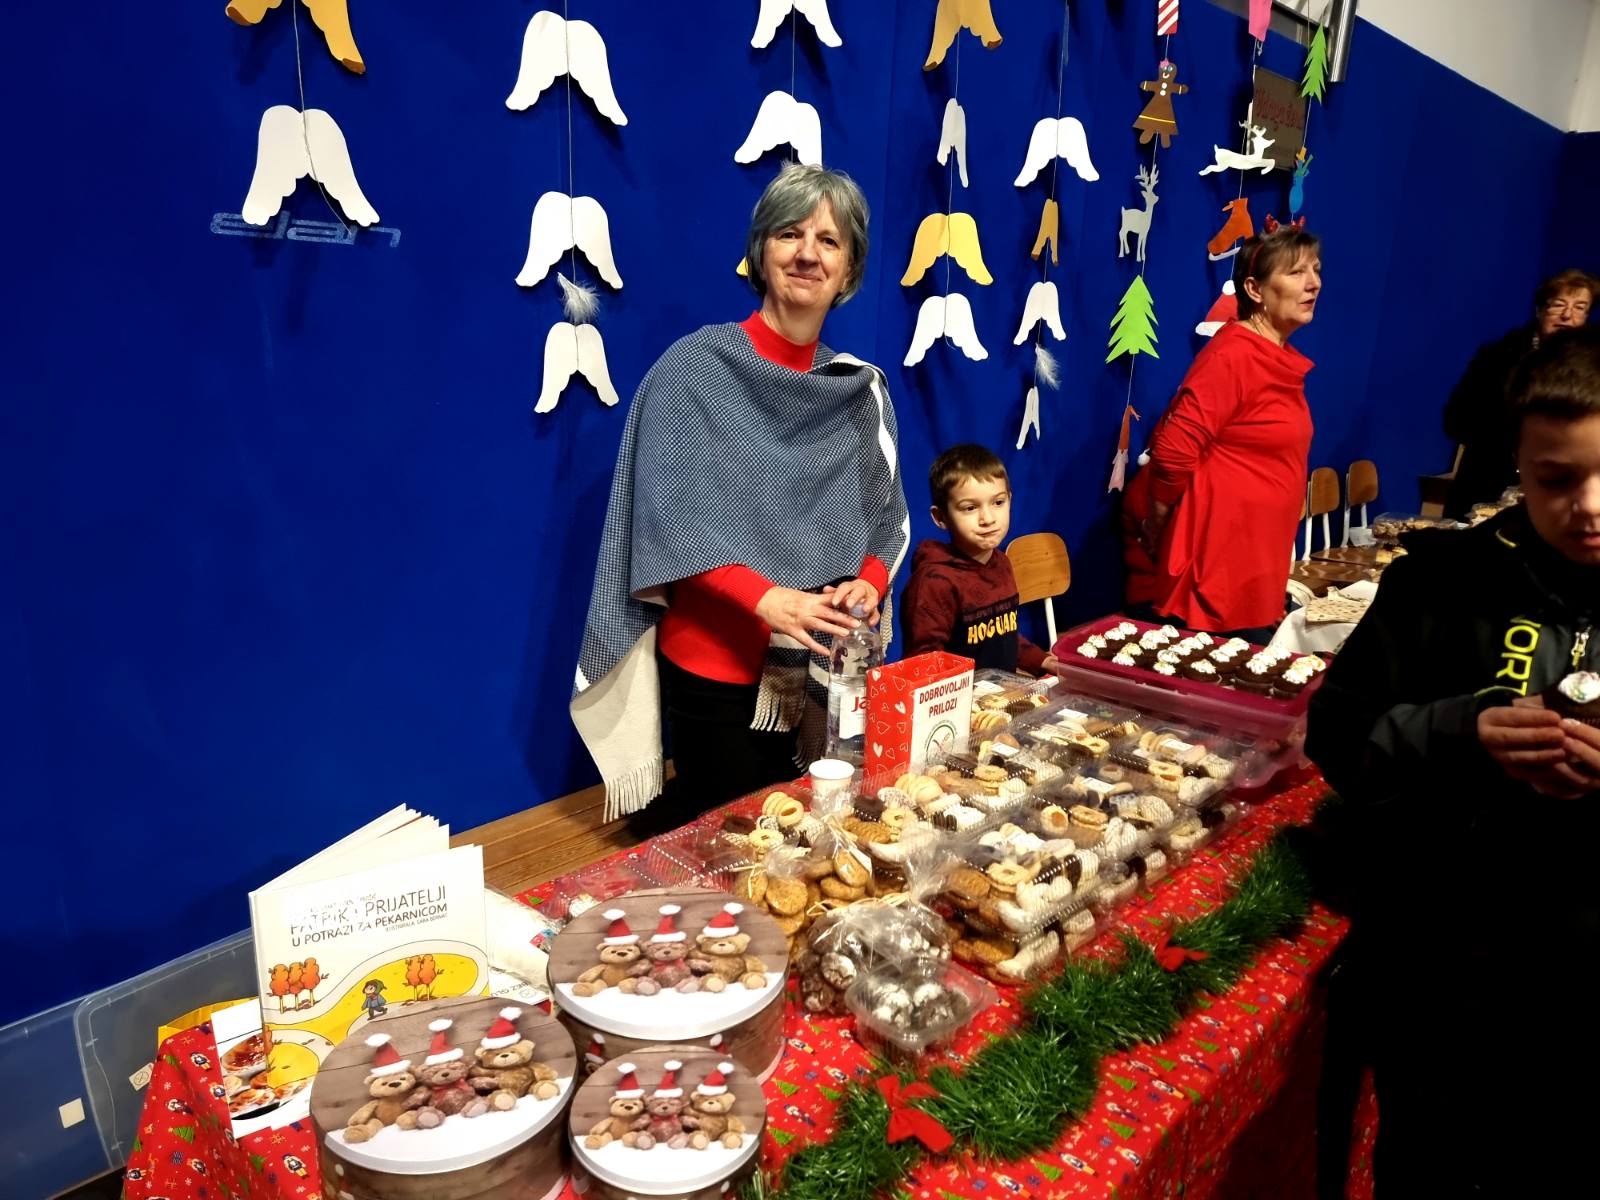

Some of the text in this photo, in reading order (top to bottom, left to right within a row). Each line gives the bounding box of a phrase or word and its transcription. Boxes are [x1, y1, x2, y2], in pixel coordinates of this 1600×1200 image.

[919, 675, 970, 704] DOBROVOLJNI
[928, 697, 958, 718] PRILOZI
[365, 885, 447, 917] PRIJATELJI
[291, 937, 301, 947] U
[304, 924, 354, 945] POTRAZI
[375, 903, 448, 928] PEKARNICOM
